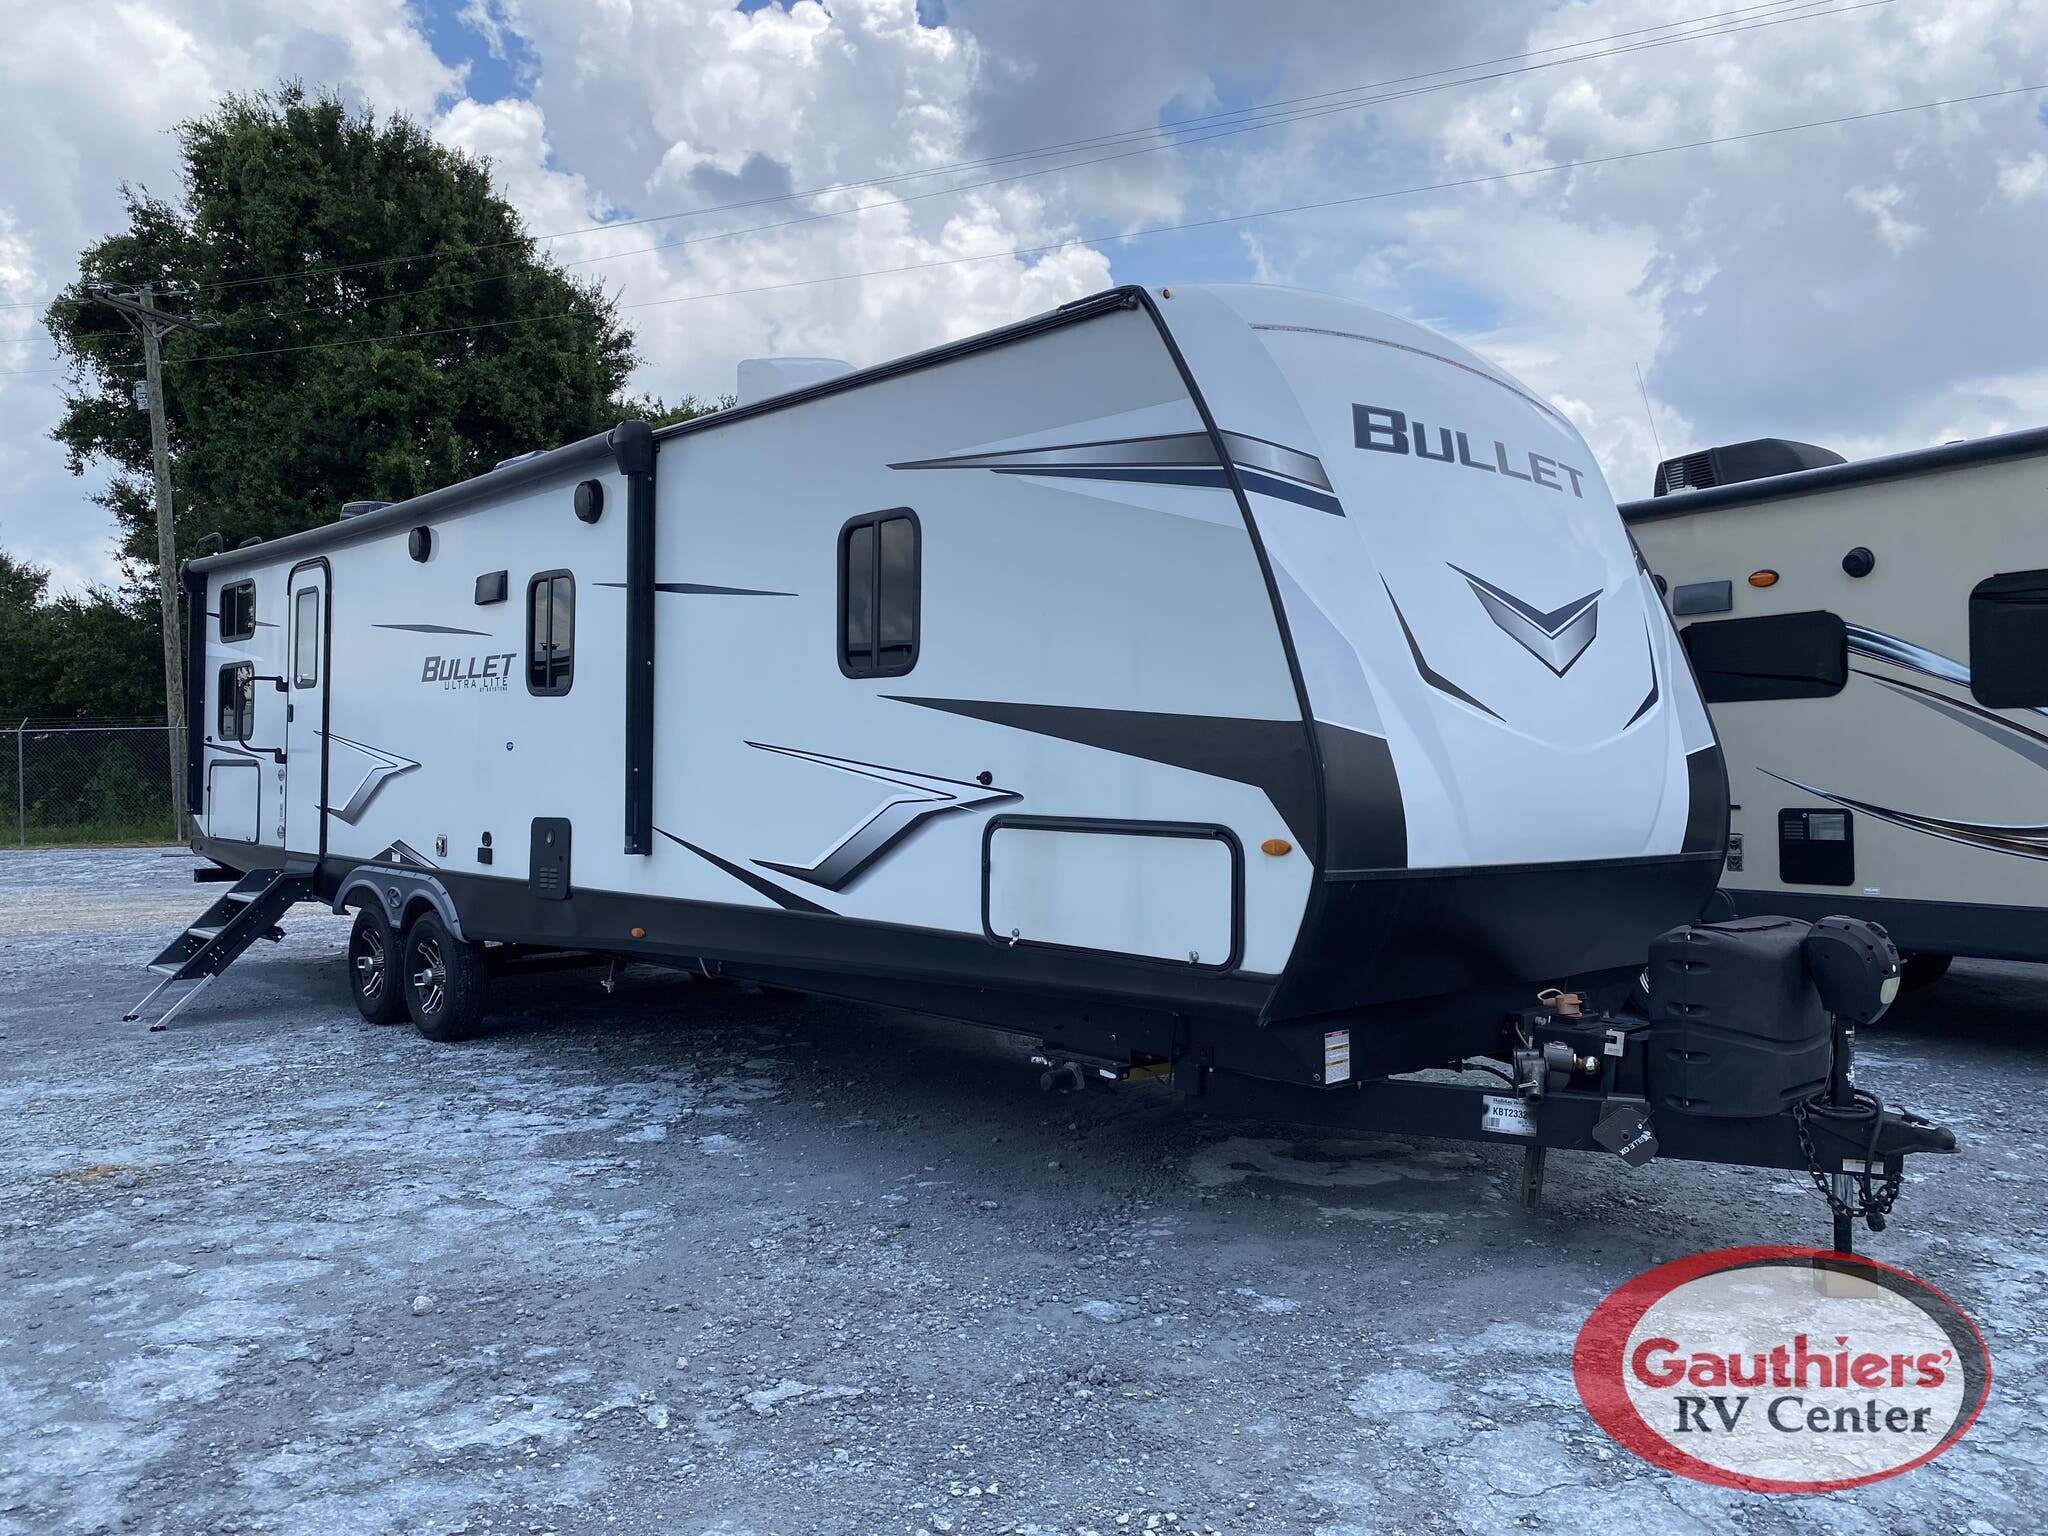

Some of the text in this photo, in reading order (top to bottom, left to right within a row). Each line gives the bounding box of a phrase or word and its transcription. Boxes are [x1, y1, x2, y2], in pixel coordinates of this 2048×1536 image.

[1352, 402, 1585, 499] BULLET
[421, 653, 517, 682] BULLET
[444, 676, 508, 690] ULTRA LITE
